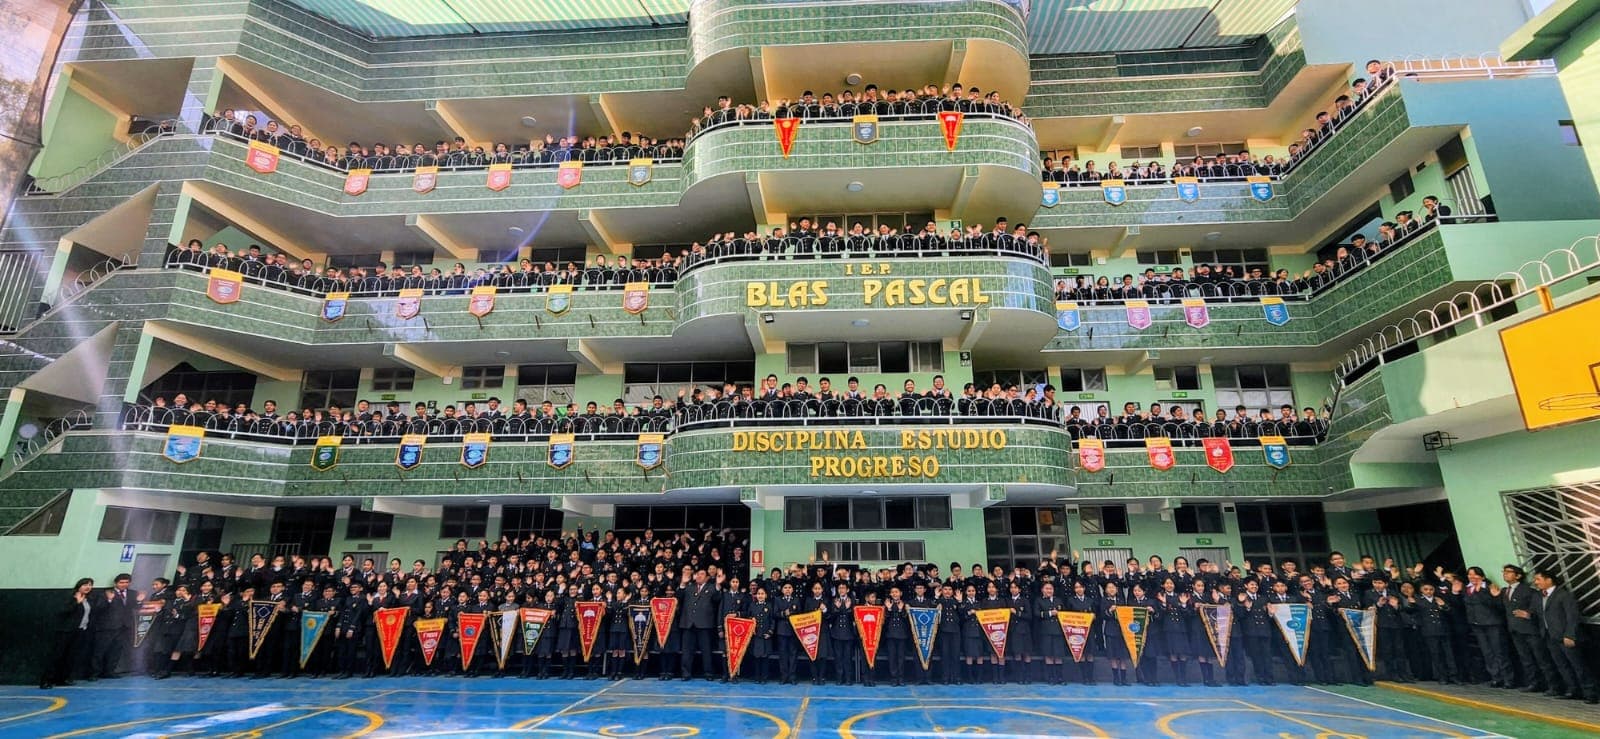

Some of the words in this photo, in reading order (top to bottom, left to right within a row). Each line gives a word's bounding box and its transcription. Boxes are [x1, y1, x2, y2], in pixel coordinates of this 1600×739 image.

[747, 280, 828, 308] BLAS
[863, 277, 989, 306] PASCAL
[732, 429, 867, 452] DISCIPLINA
[901, 428, 1007, 450] ESTUDIO
[810, 455, 940, 478] PROGRESO
